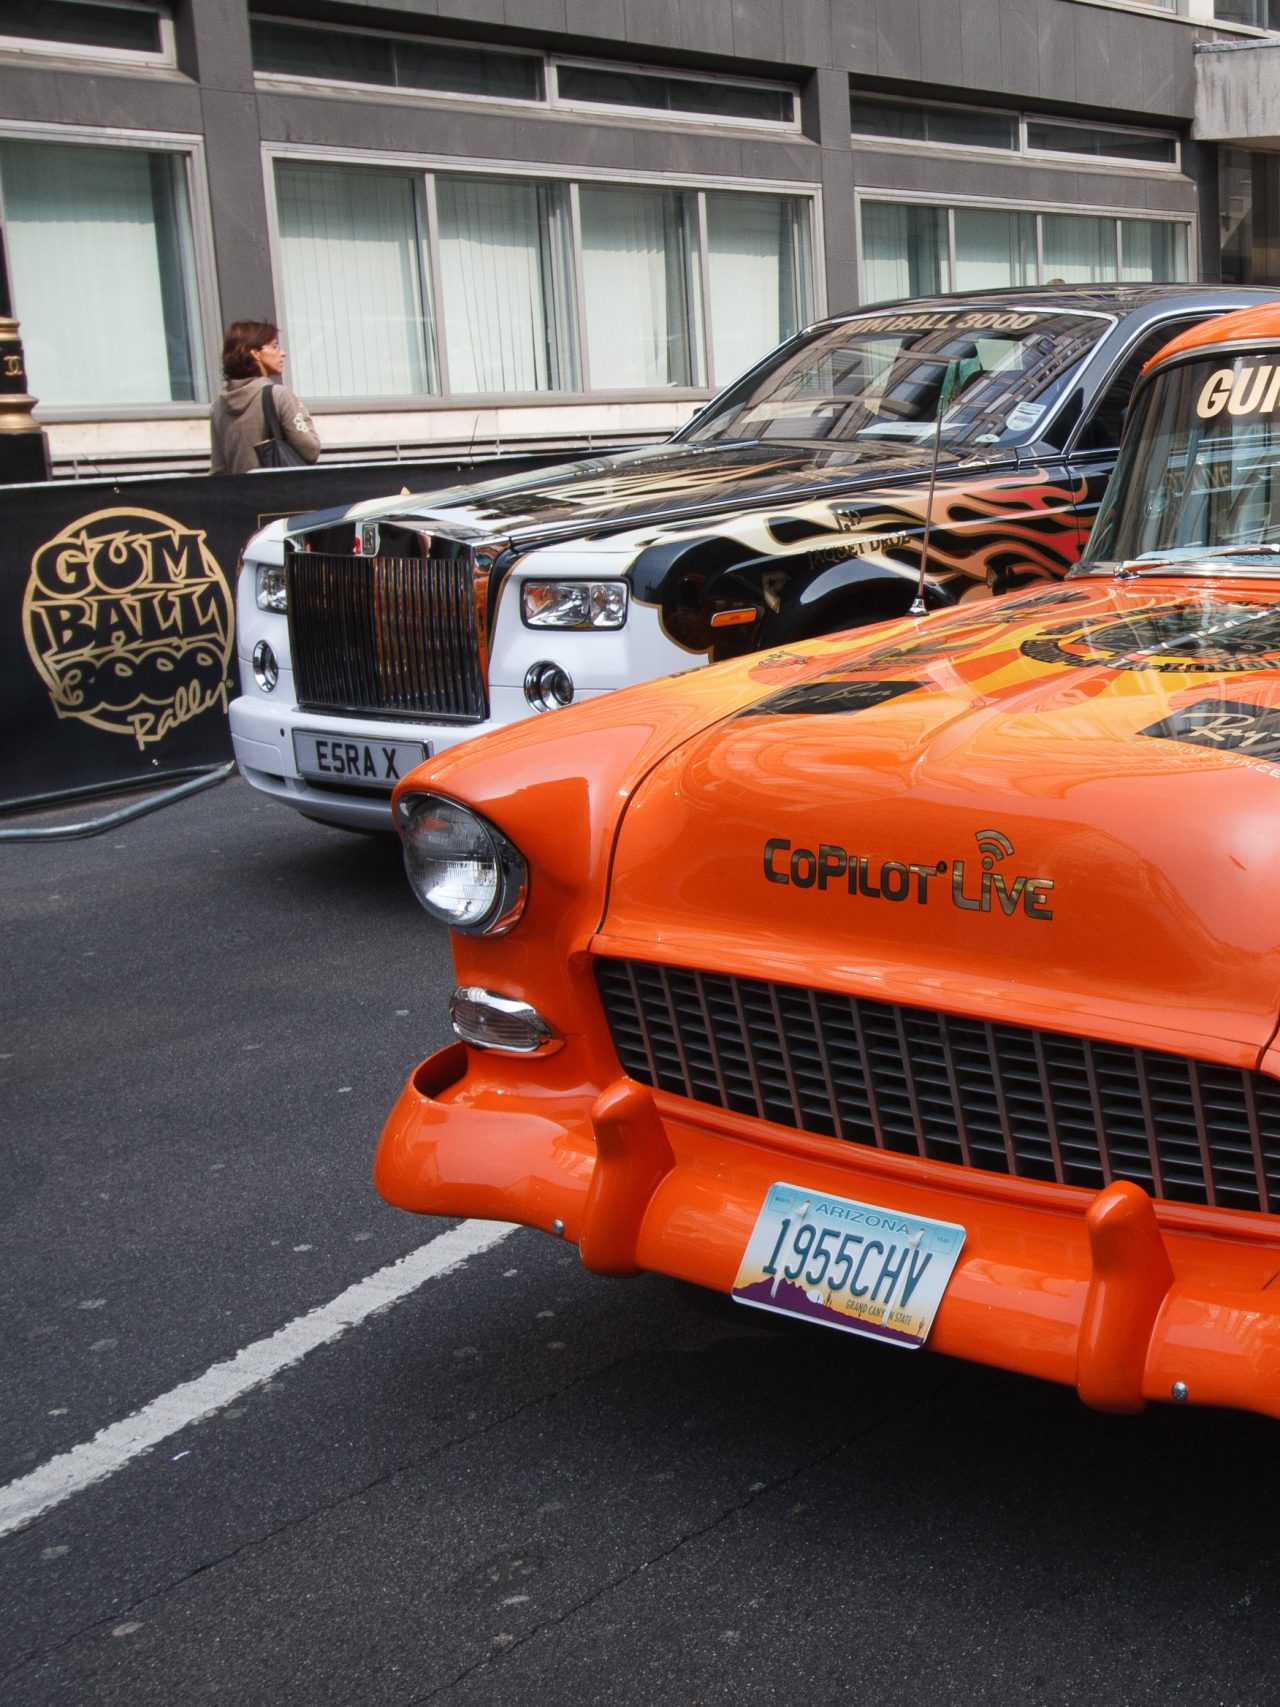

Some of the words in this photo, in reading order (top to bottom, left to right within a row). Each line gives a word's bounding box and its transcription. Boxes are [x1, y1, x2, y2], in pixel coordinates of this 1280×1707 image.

[831, 312, 956, 336] GUMBALL
[957, 312, 1038, 331] 3000
[29, 583, 227, 658] BALL
[815, 1203, 912, 1236] ARIZONA
[762, 1218, 933, 1308] 1955CHV
[845, 1299, 868, 1314] GRAND
[868, 1305, 893, 1321] CANYN
[895, 1312, 913, 1326] STATE
